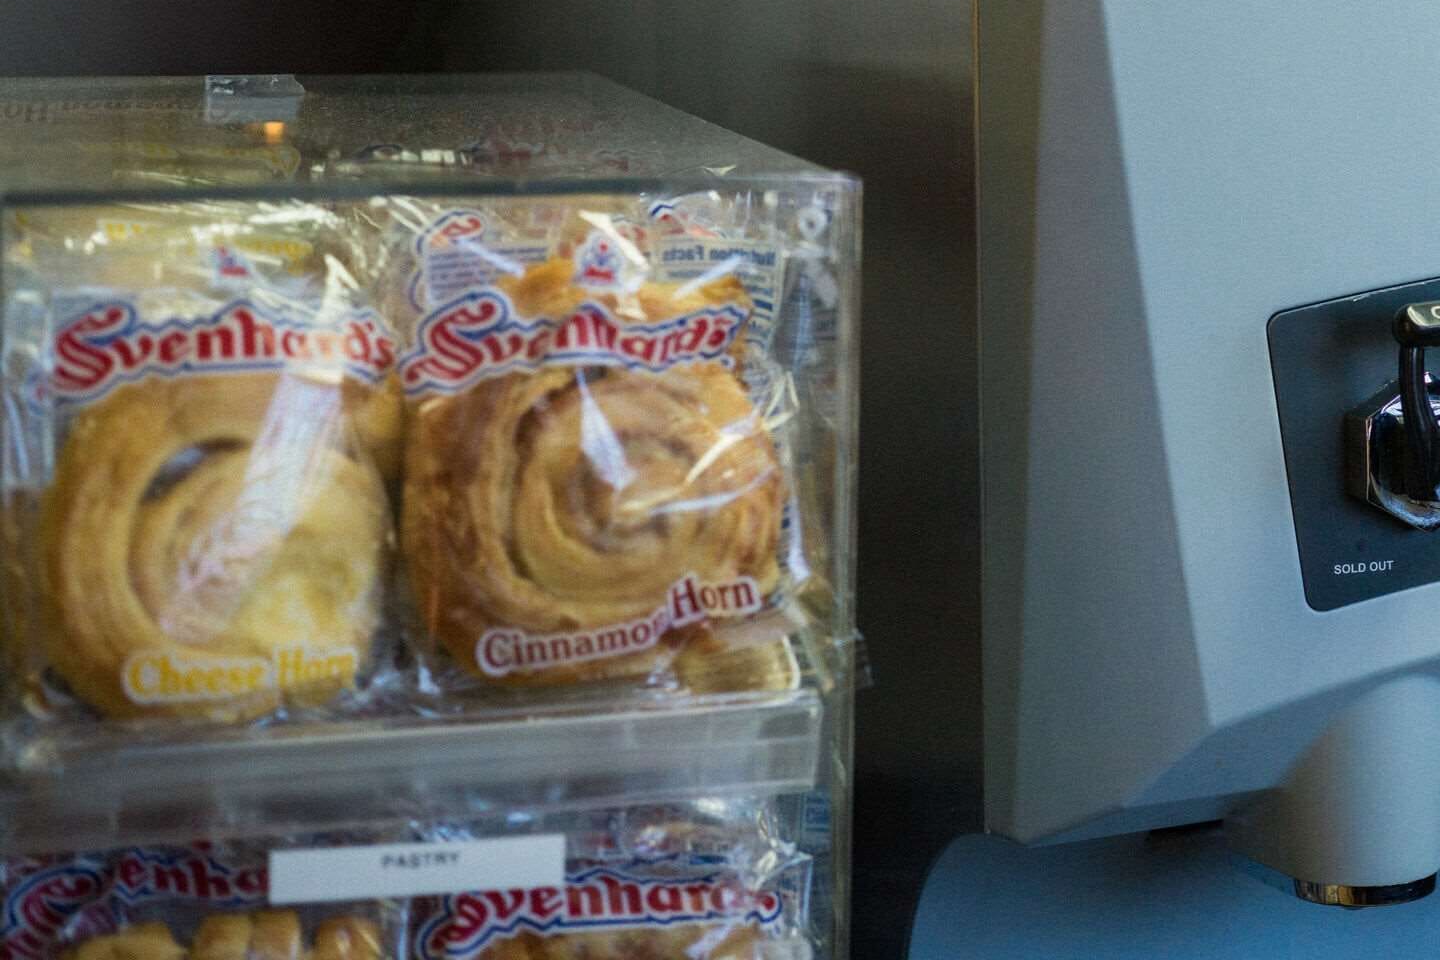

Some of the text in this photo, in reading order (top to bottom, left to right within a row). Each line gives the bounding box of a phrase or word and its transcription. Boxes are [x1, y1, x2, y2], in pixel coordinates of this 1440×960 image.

[1334, 560, 1395, 575] SOLD OUT
[671, 577, 756, 620] Horn
[127, 654, 265, 691] Cheese
[381, 851, 460, 869] PASTRY
